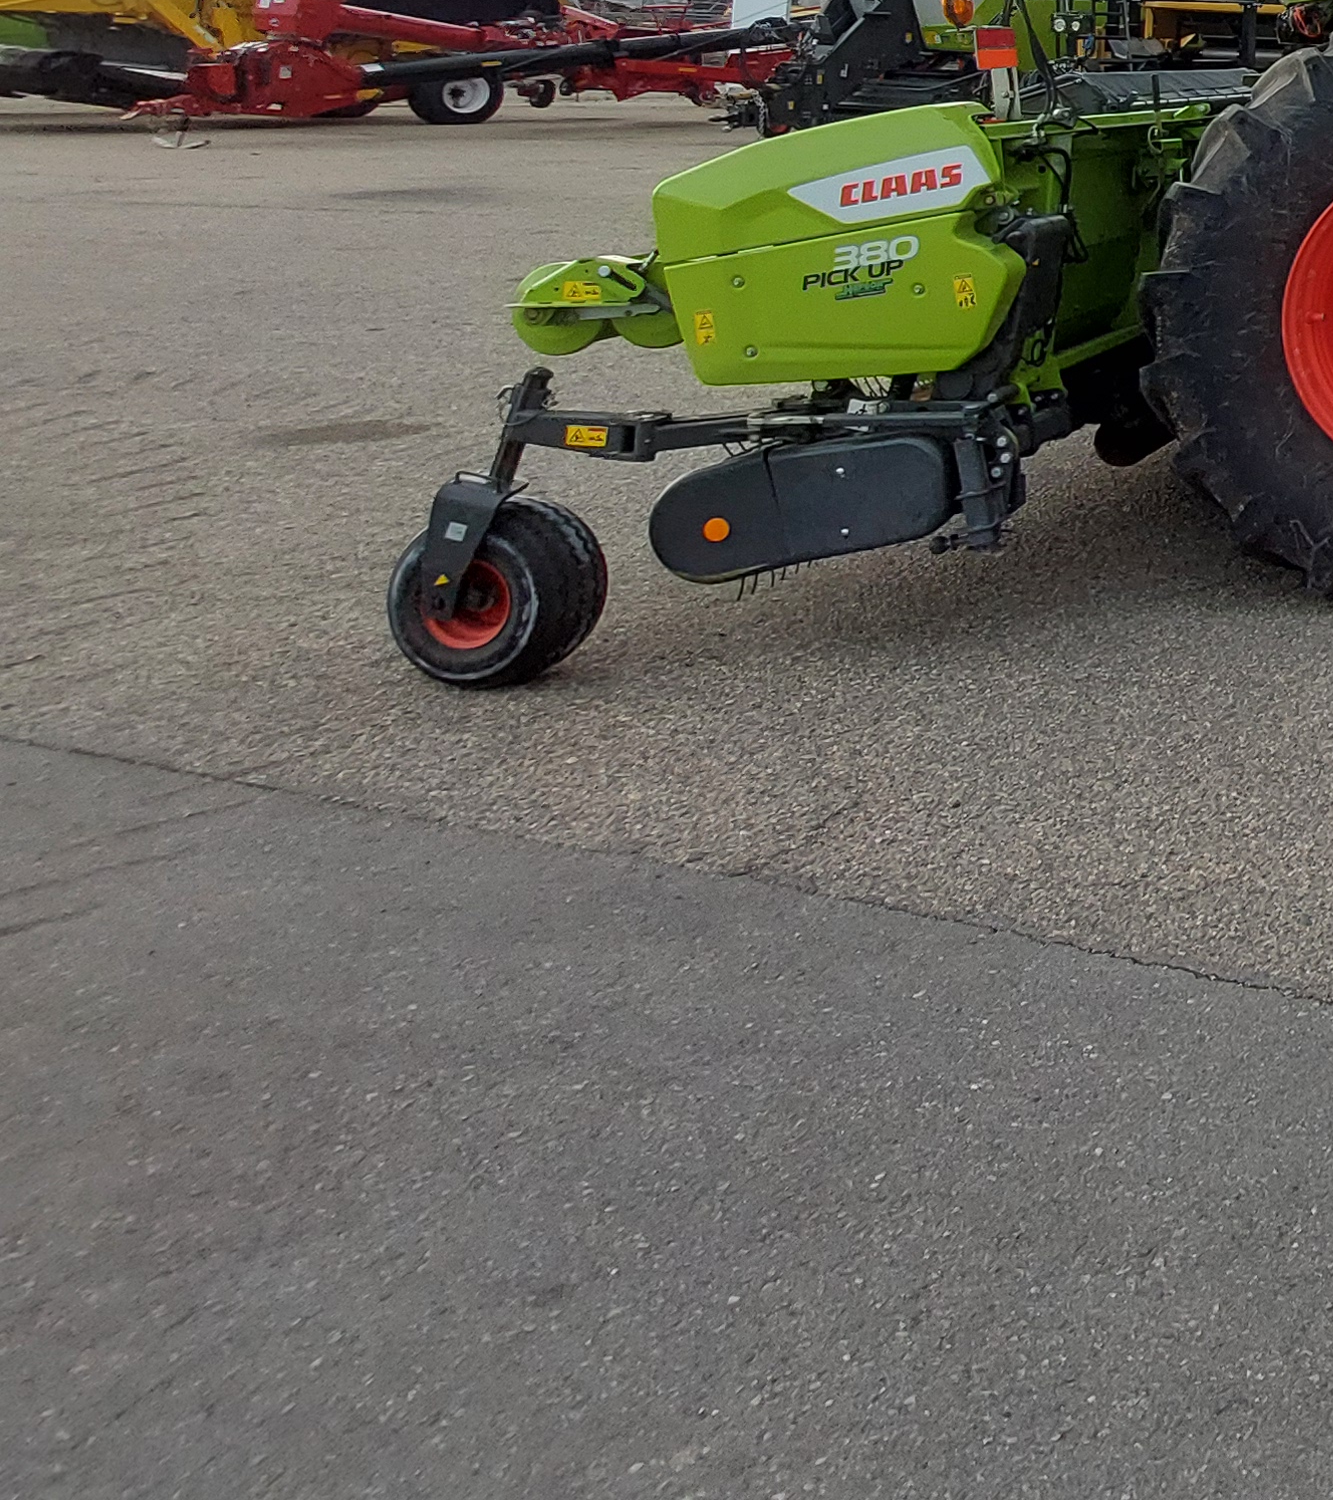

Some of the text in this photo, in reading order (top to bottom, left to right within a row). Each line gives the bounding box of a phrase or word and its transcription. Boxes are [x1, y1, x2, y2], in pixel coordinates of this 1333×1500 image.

[839, 163, 963, 208] CLAAS
[833, 235, 920, 271] 380
[803, 265, 860, 291] PICK
[867, 258, 904, 279] UP
